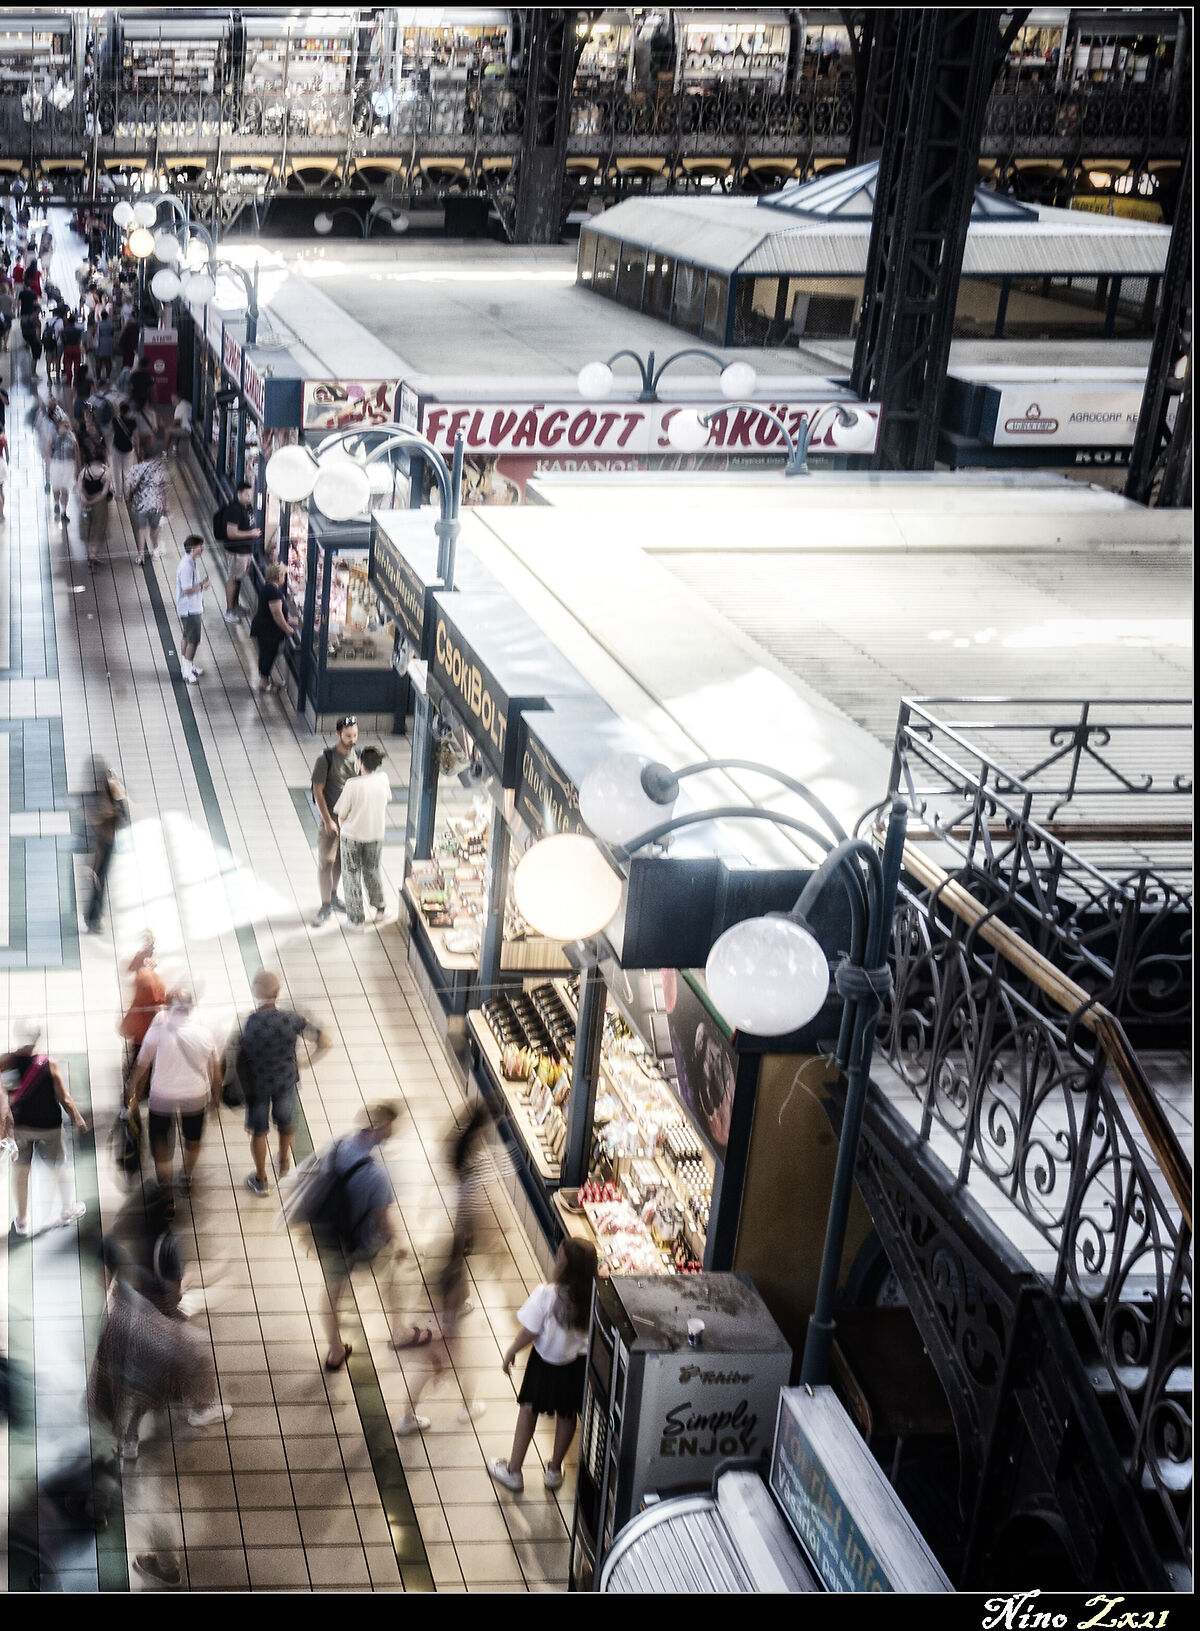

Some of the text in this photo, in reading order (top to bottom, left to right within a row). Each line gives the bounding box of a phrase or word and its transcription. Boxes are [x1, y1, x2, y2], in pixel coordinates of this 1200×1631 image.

[426, 404, 645, 447] FELVÁGOTT
[663, 1400, 757, 1440] Simply
[660, 1435, 758, 1457] ENJOY
